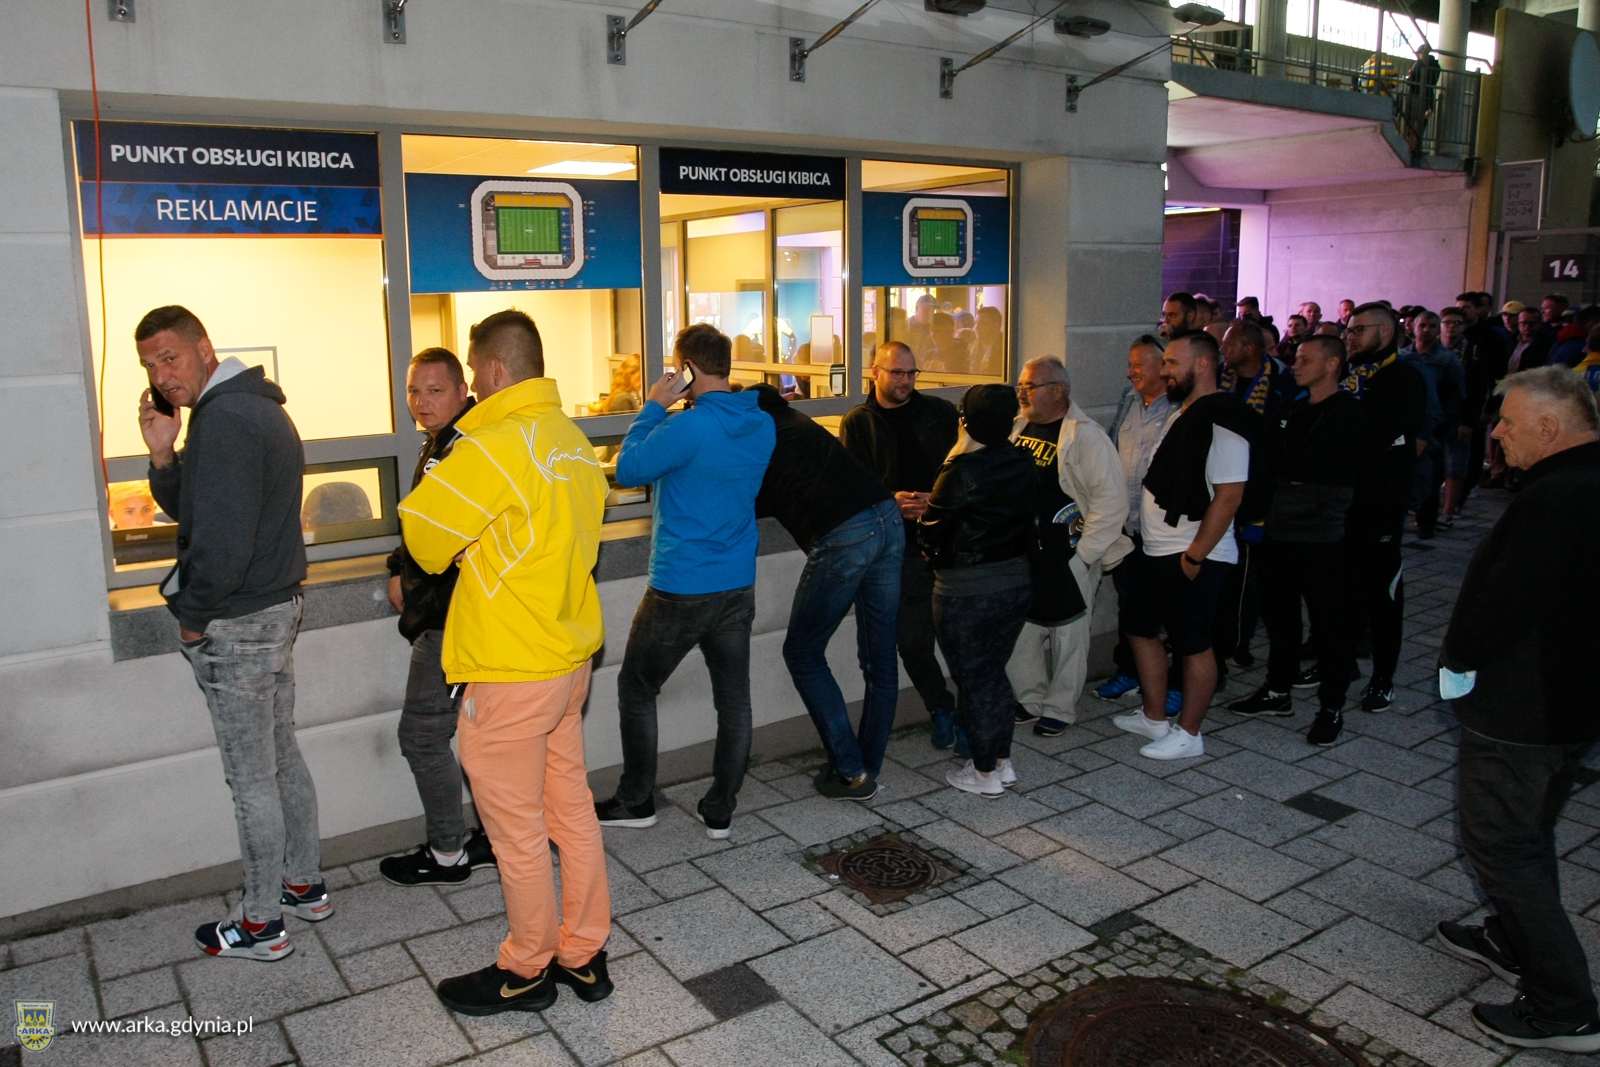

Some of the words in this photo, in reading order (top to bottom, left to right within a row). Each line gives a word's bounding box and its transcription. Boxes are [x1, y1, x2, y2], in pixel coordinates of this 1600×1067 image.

[110, 144, 188, 164] PUNKT
[192, 147, 283, 168] OBSŁUGI
[287, 150, 355, 169] KIBICA
[678, 165, 728, 181] PUNKT
[729, 167, 786, 184] OBSŁUGI
[788, 170, 830, 185] KIBICA
[157, 198, 319, 223] REKLAMACJE
[1505, 207, 1533, 216] 20-24
[1549, 259, 1579, 278] 14
